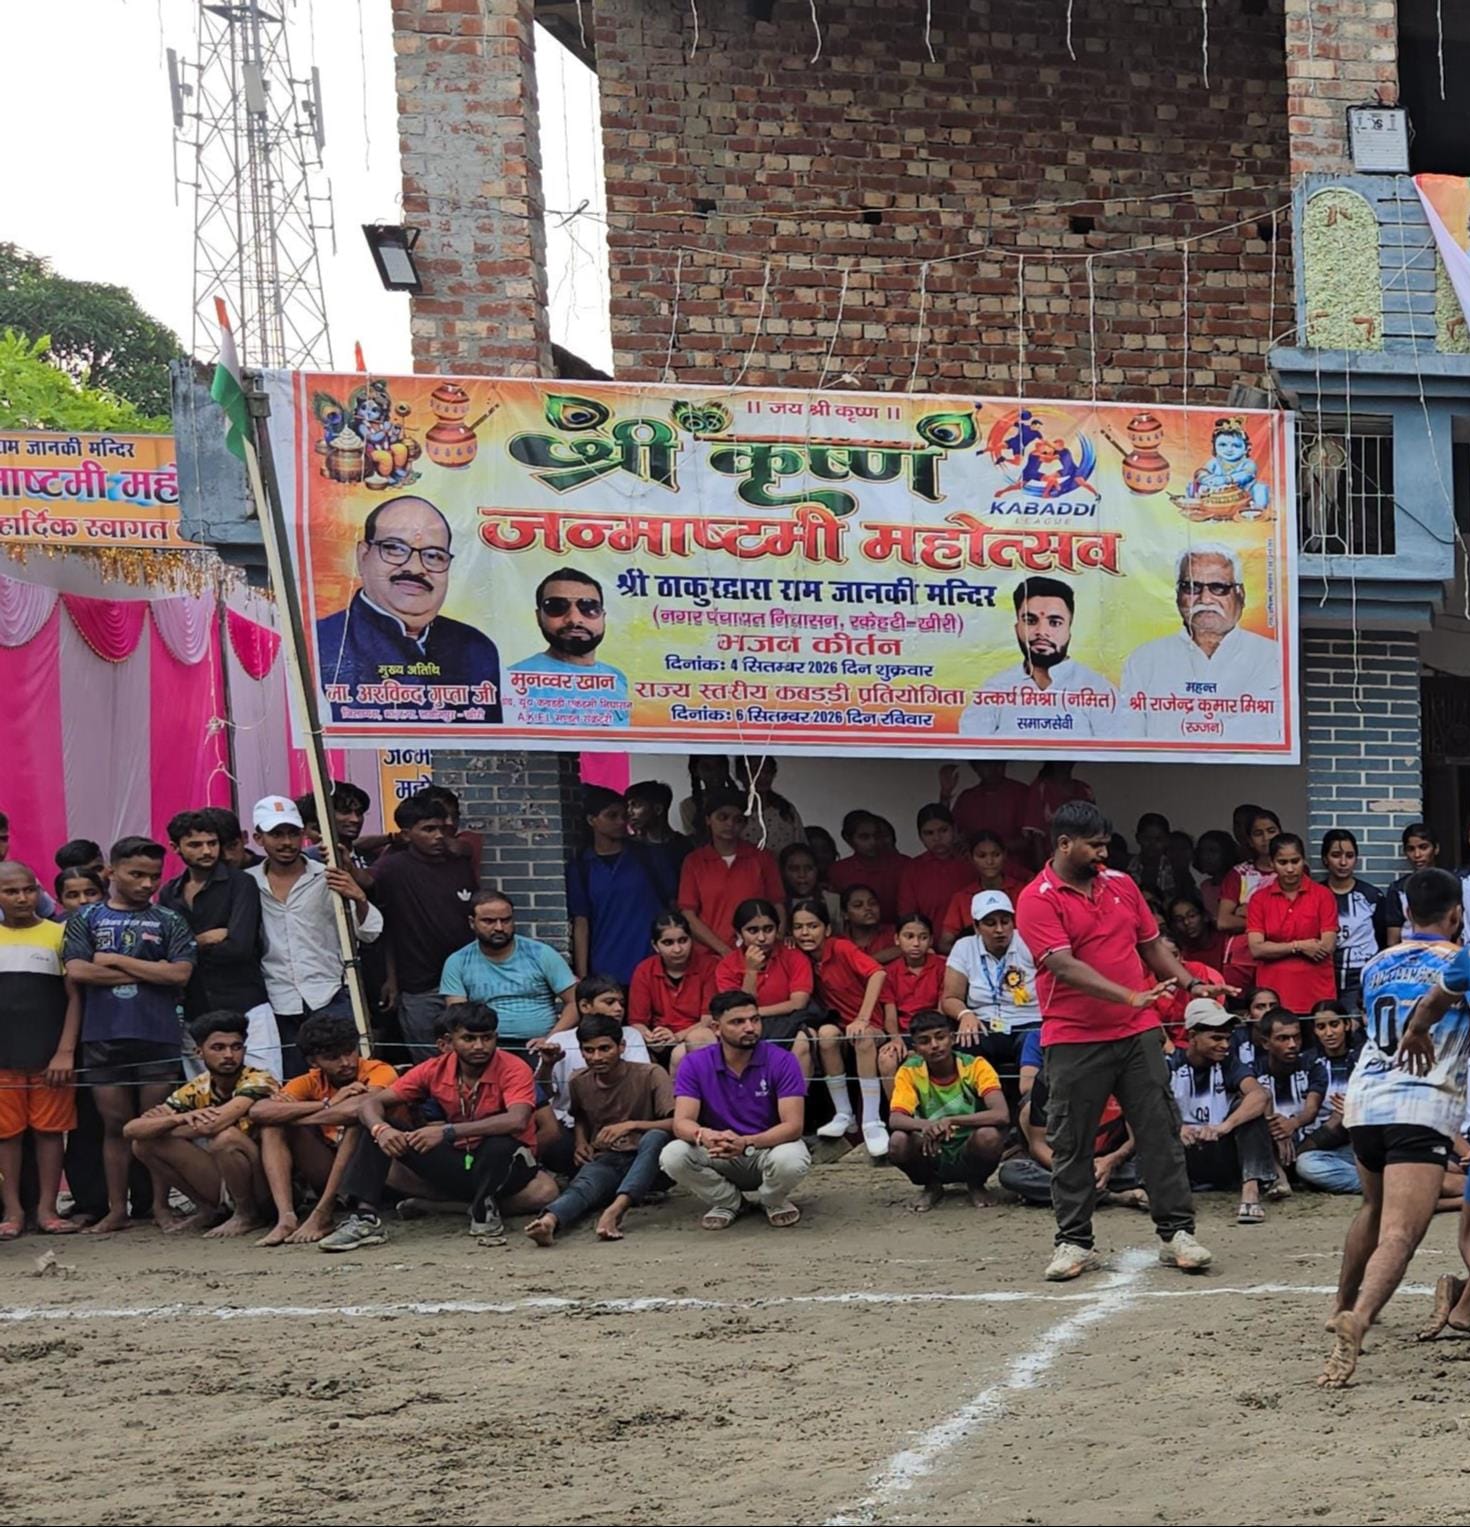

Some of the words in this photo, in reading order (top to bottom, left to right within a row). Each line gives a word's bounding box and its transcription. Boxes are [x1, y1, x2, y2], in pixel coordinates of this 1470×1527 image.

[768, 402, 802, 416] जय
[808, 400, 831, 419] श्री
[835, 405, 879, 423] कृष्ण
[0, 440, 19, 455] ाम
[26, 437, 82, 456] जानकी
[88, 438, 135, 458] मन्दिर
[507, 416, 682, 494] श्री
[708, 441, 948, 516] कृष्ण
[990, 501, 1096, 516] KABADDI
[83, 519, 169, 539] स्वागत
[1015, 517, 1072, 525] LEAGUE
[478, 504, 848, 562] जन्माष्टमी
[861, 513, 1125, 576] महोत्सव
[617, 569, 649, 597] श्री
[654, 575, 773, 607] ठाकुरद्वारा
[780, 579, 825, 602] राम
[829, 577, 919, 606] जानकी
[924, 579, 997, 608] मन्दिर
[653, 605, 703, 629] (नगर
[707, 607, 766, 628] पंचायत
[717, 632, 800, 654] भजन
[812, 632, 903, 657] कीर्तन
[378, 664, 403, 678] मुख्य
[407, 662, 440, 676] अतिथि
[730, 659, 738, 672] 4
[743, 656, 805, 674] सितम्बर
[808, 661, 838, 675] 2026
[843, 659, 872, 676] दिन
[875, 663, 935, 682] शुक्रवार
[357, 679, 425, 705] अरविन्द
[427, 684, 469, 709] गुप्ता
[471, 681, 497, 705] जी
[511, 672, 572, 693] मुनव्वर
[576, 672, 614, 690] खान
[635, 680, 691, 699] राज्य
[699, 680, 768, 702] स्तरीय
[858, 683, 965, 706] प्रतियोगिता
[1185, 681, 1217, 694] महन्त
[973, 686, 1017, 708] उत्कर्ष
[1021, 688, 1057, 708] मिश्रा
[1062, 688, 1117, 713] (नमित)
[1129, 692, 1147, 712] श्री
[1150, 693, 1194, 715] राजेन्द्र
[1198, 698, 1237, 720] कुमार
[1240, 695, 1275, 714] मिश्रा
[736, 710, 743, 722] 6
[747, 707, 810, 725] सितम्बर
[812, 711, 843, 725] 2026
[846, 709, 877, 726] दिन
[881, 710, 933, 728] रविवार
[1017, 714, 1073, 731] समाजसेवी
[1196, 1106, 1210, 1123] 09
